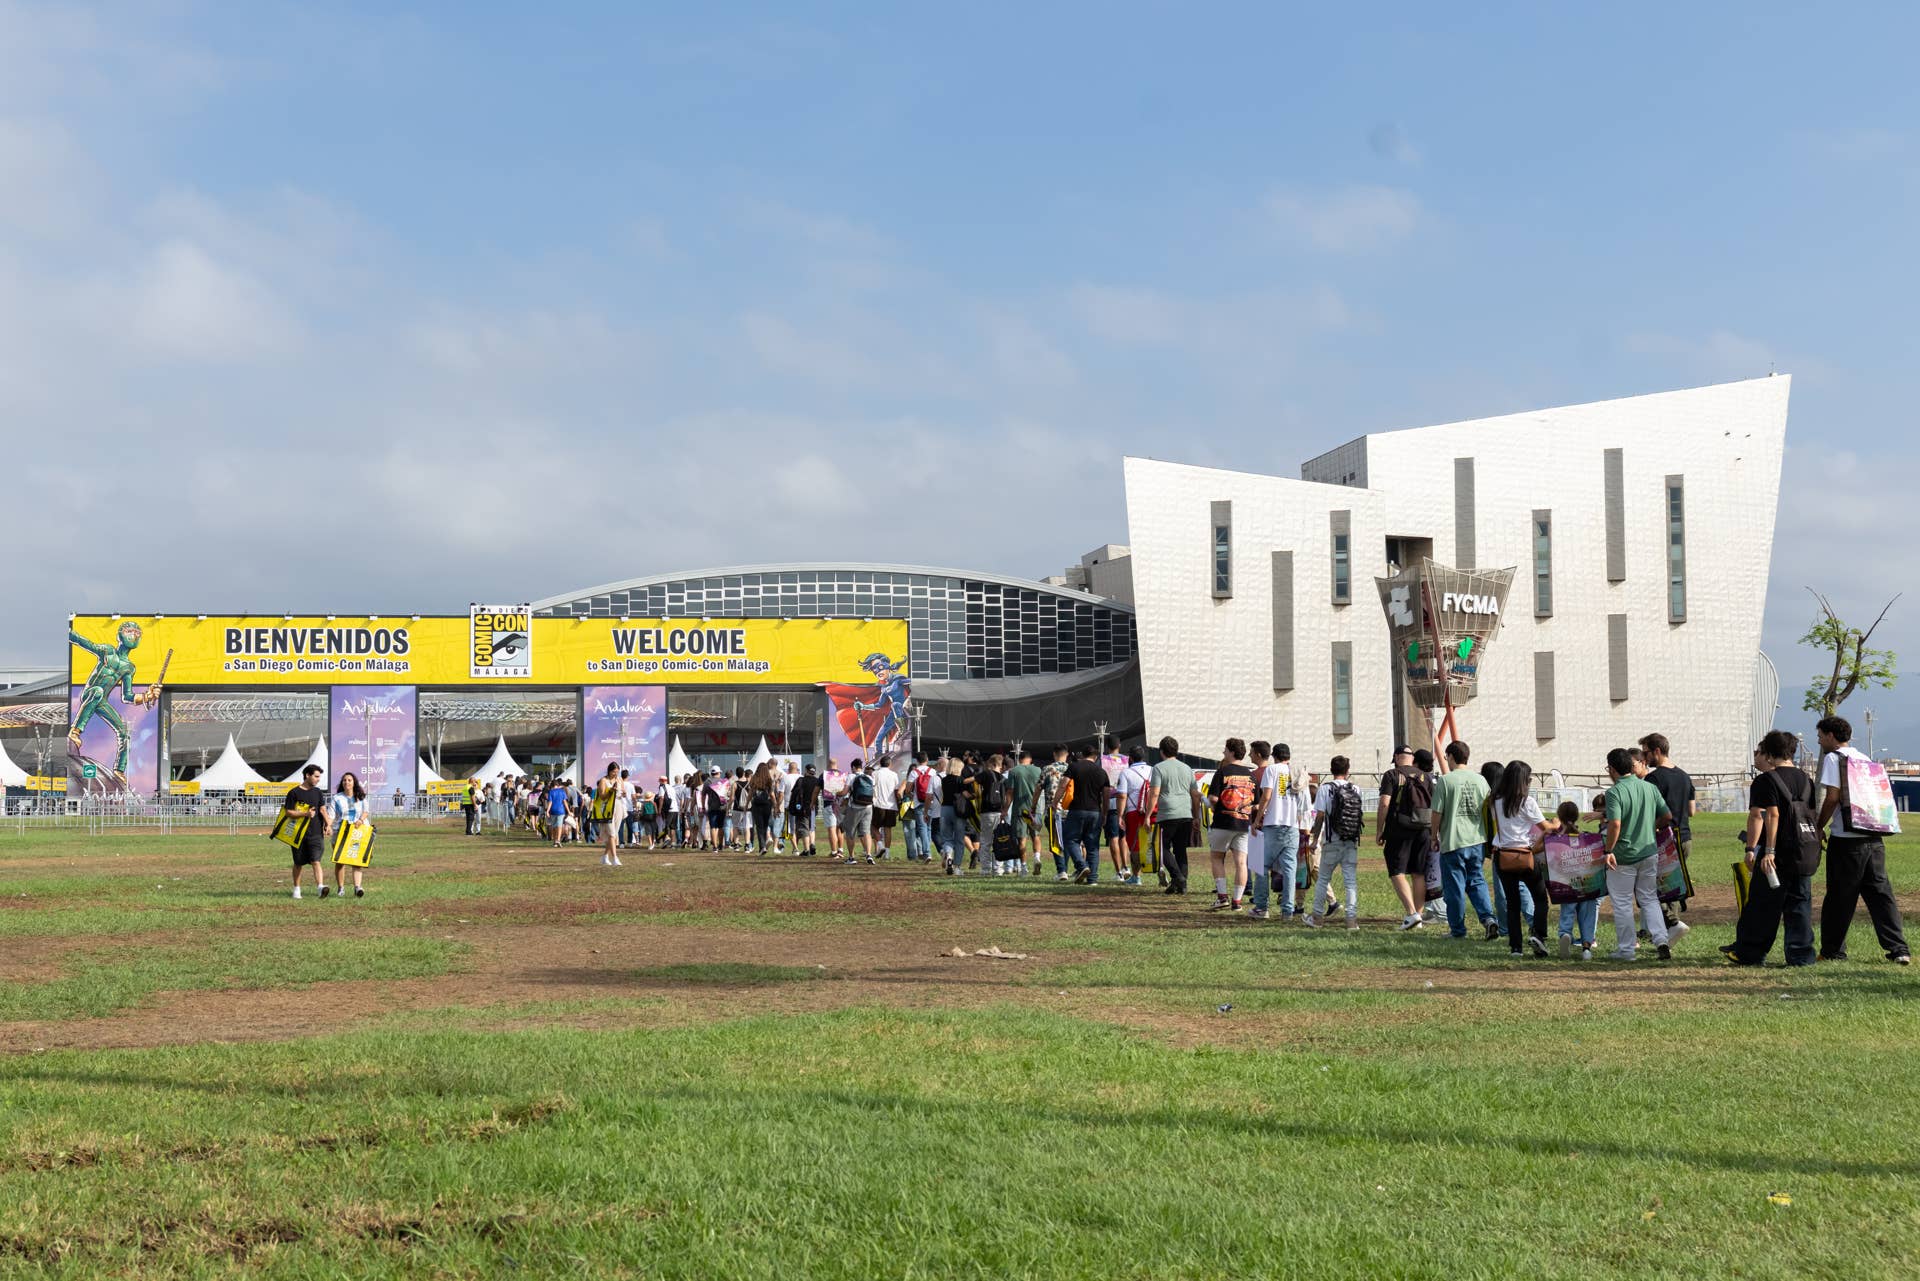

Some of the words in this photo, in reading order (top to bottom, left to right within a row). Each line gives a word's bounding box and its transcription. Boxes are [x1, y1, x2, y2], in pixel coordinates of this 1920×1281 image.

[1442, 592, 1499, 615] FYCMA
[493, 614, 528, 632] CON
[225, 628, 409, 654] BIENVENIDOS
[475, 614, 493, 666] COMIC
[612, 629, 745, 654] WELCOME
[224, 661, 231, 670] a
[233, 659, 256, 670] San
[259, 659, 293, 672] Diego
[297, 658, 362, 670] Comic-Con
[365, 658, 409, 672] Málaga
[587, 661, 598, 670] to
[601, 659, 622, 670] San
[626, 659, 658, 672] Diego
[662, 658, 724, 670] Comic-Con
[727, 658, 769, 672] Málaga
[594, 698, 656, 714] Andalucía
